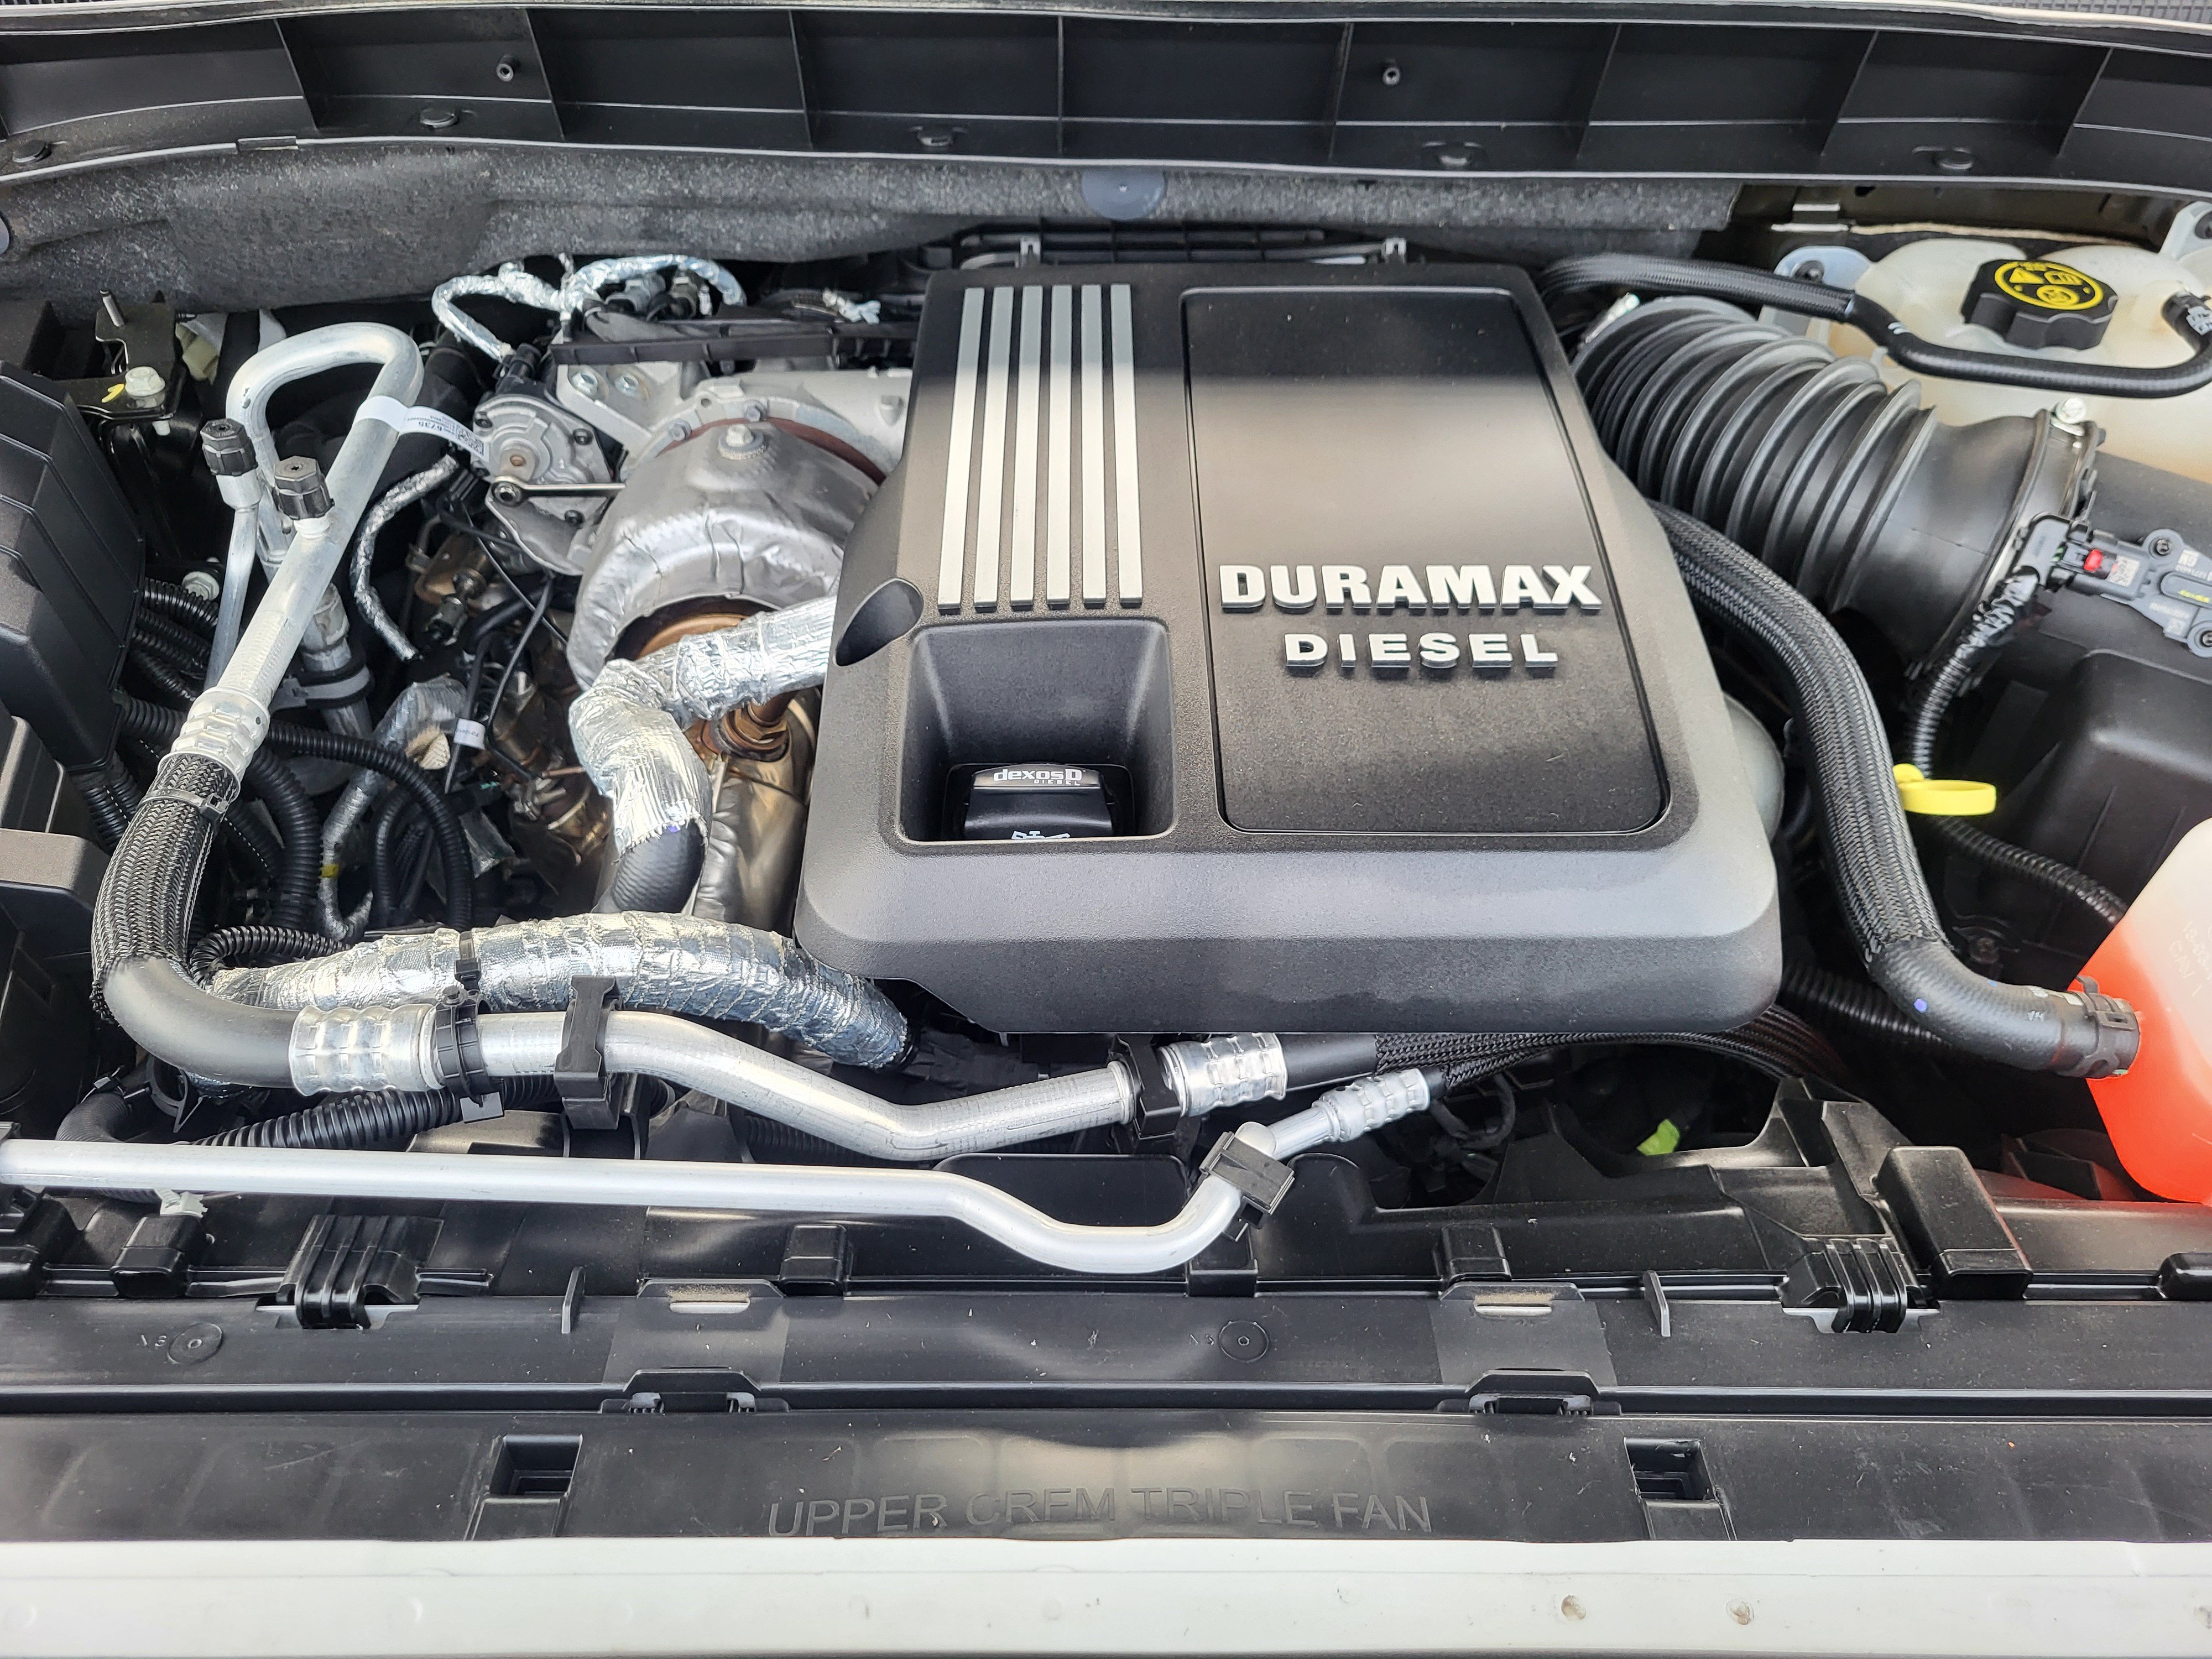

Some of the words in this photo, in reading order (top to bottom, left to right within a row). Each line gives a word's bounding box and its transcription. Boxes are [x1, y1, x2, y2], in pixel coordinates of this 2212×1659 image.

[1219, 565, 1602, 609] DURAMAX
[1284, 633, 1559, 667] DIESEL
[768, 1493, 948, 1536] UPPER
[1131, 1488, 1317, 1526] TRIPLE
[1332, 1493, 1432, 1532] FAN
